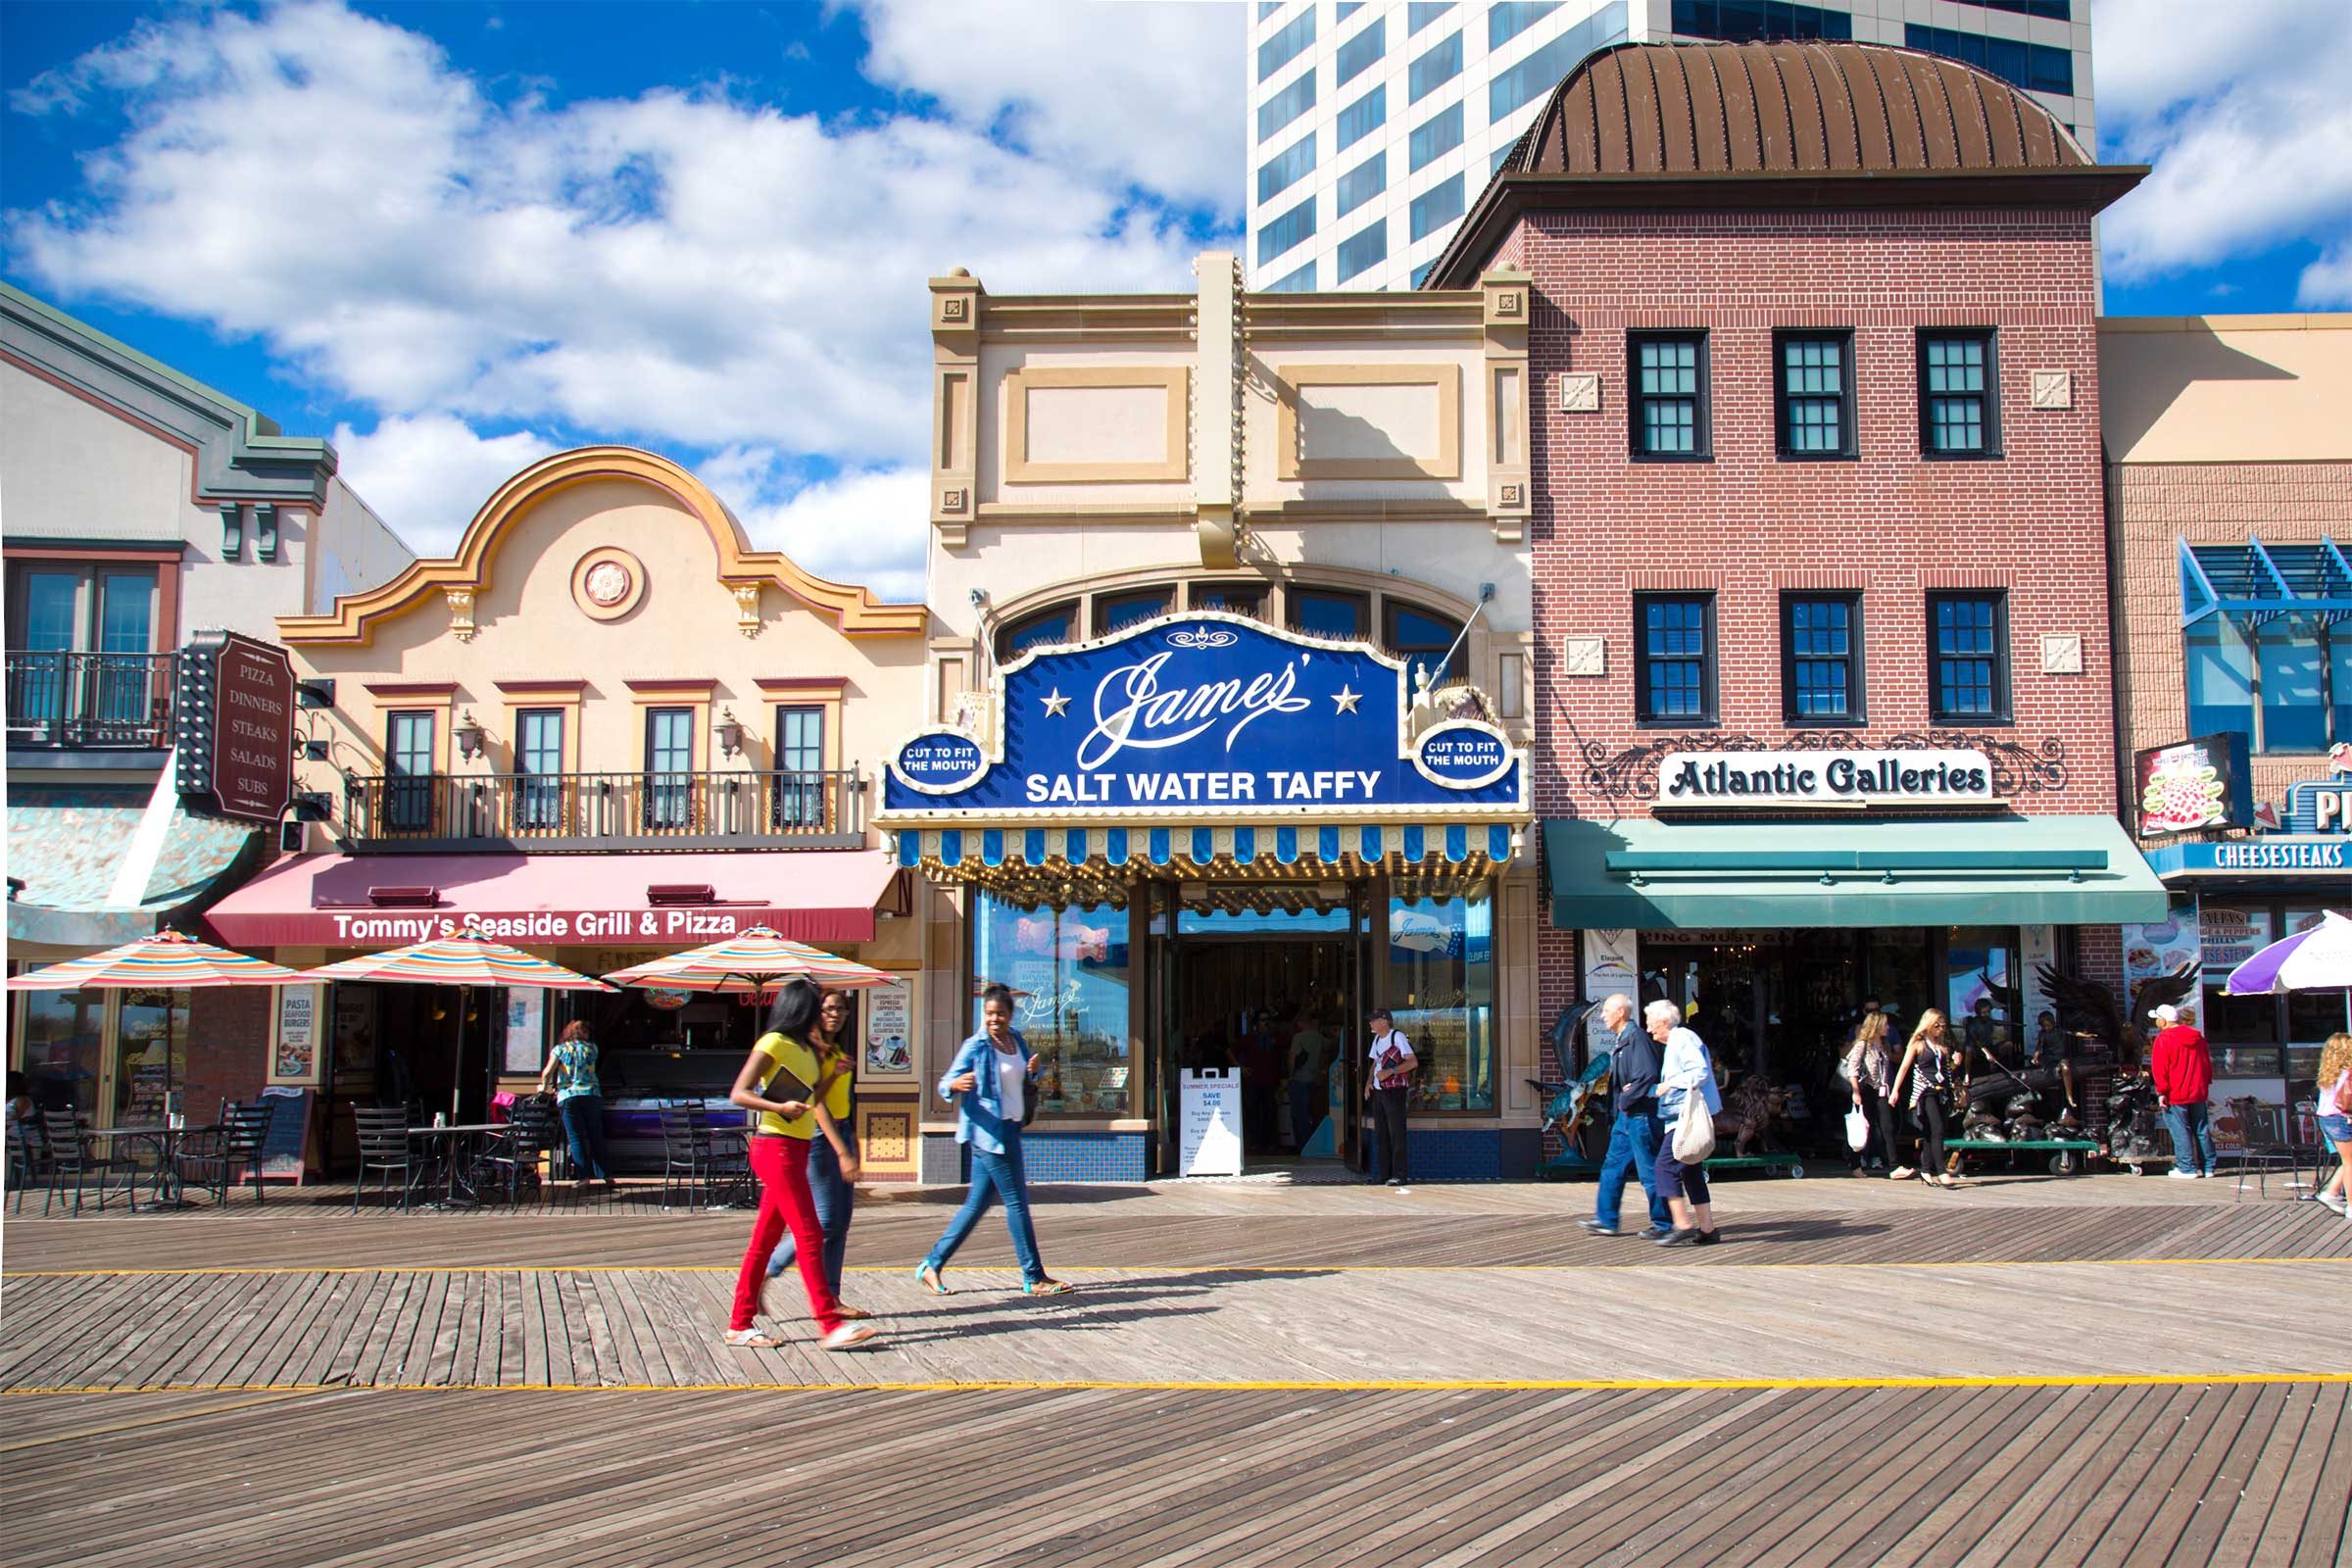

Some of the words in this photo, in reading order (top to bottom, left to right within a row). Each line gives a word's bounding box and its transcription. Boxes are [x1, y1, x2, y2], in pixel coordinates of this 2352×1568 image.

[239, 664, 274, 686] PIZZA
[229, 690, 283, 715] DINNERS
[231, 719, 278, 742] STEAKS
[906, 748, 930, 759] CUT
[935, 748, 951, 758] TO
[955, 747, 975, 758] FIT
[1428, 743, 1452, 753] CUT
[1456, 743, 1473, 753] TO
[1476, 742, 1496, 753] FIT
[230, 748, 277, 769] SALADS
[904, 760, 928, 771] THE
[931, 760, 977, 771] MOUTH
[1425, 755, 1450, 765] THE
[1453, 755, 1499, 765] MOUTH
[237, 777, 269, 795] SUBS
[1025, 772, 1117, 803] SALT
[1126, 771, 1255, 801] WATER
[1266, 771, 1382, 800] TAFFY
[1669, 760, 1816, 795] Atlantic
[1826, 759, 1985, 793] Galleries
[2215, 844, 2343, 866] CHEESESTEAKS
[333, 914, 455, 943] Tommy's
[463, 911, 567, 937] Seaside
[575, 911, 631, 936] Grill
[638, 911, 659, 935] &
[667, 911, 736, 934] Pizza
[285, 1000, 311, 1009] PASTA
[283, 1019, 311, 1028] BURGERS
